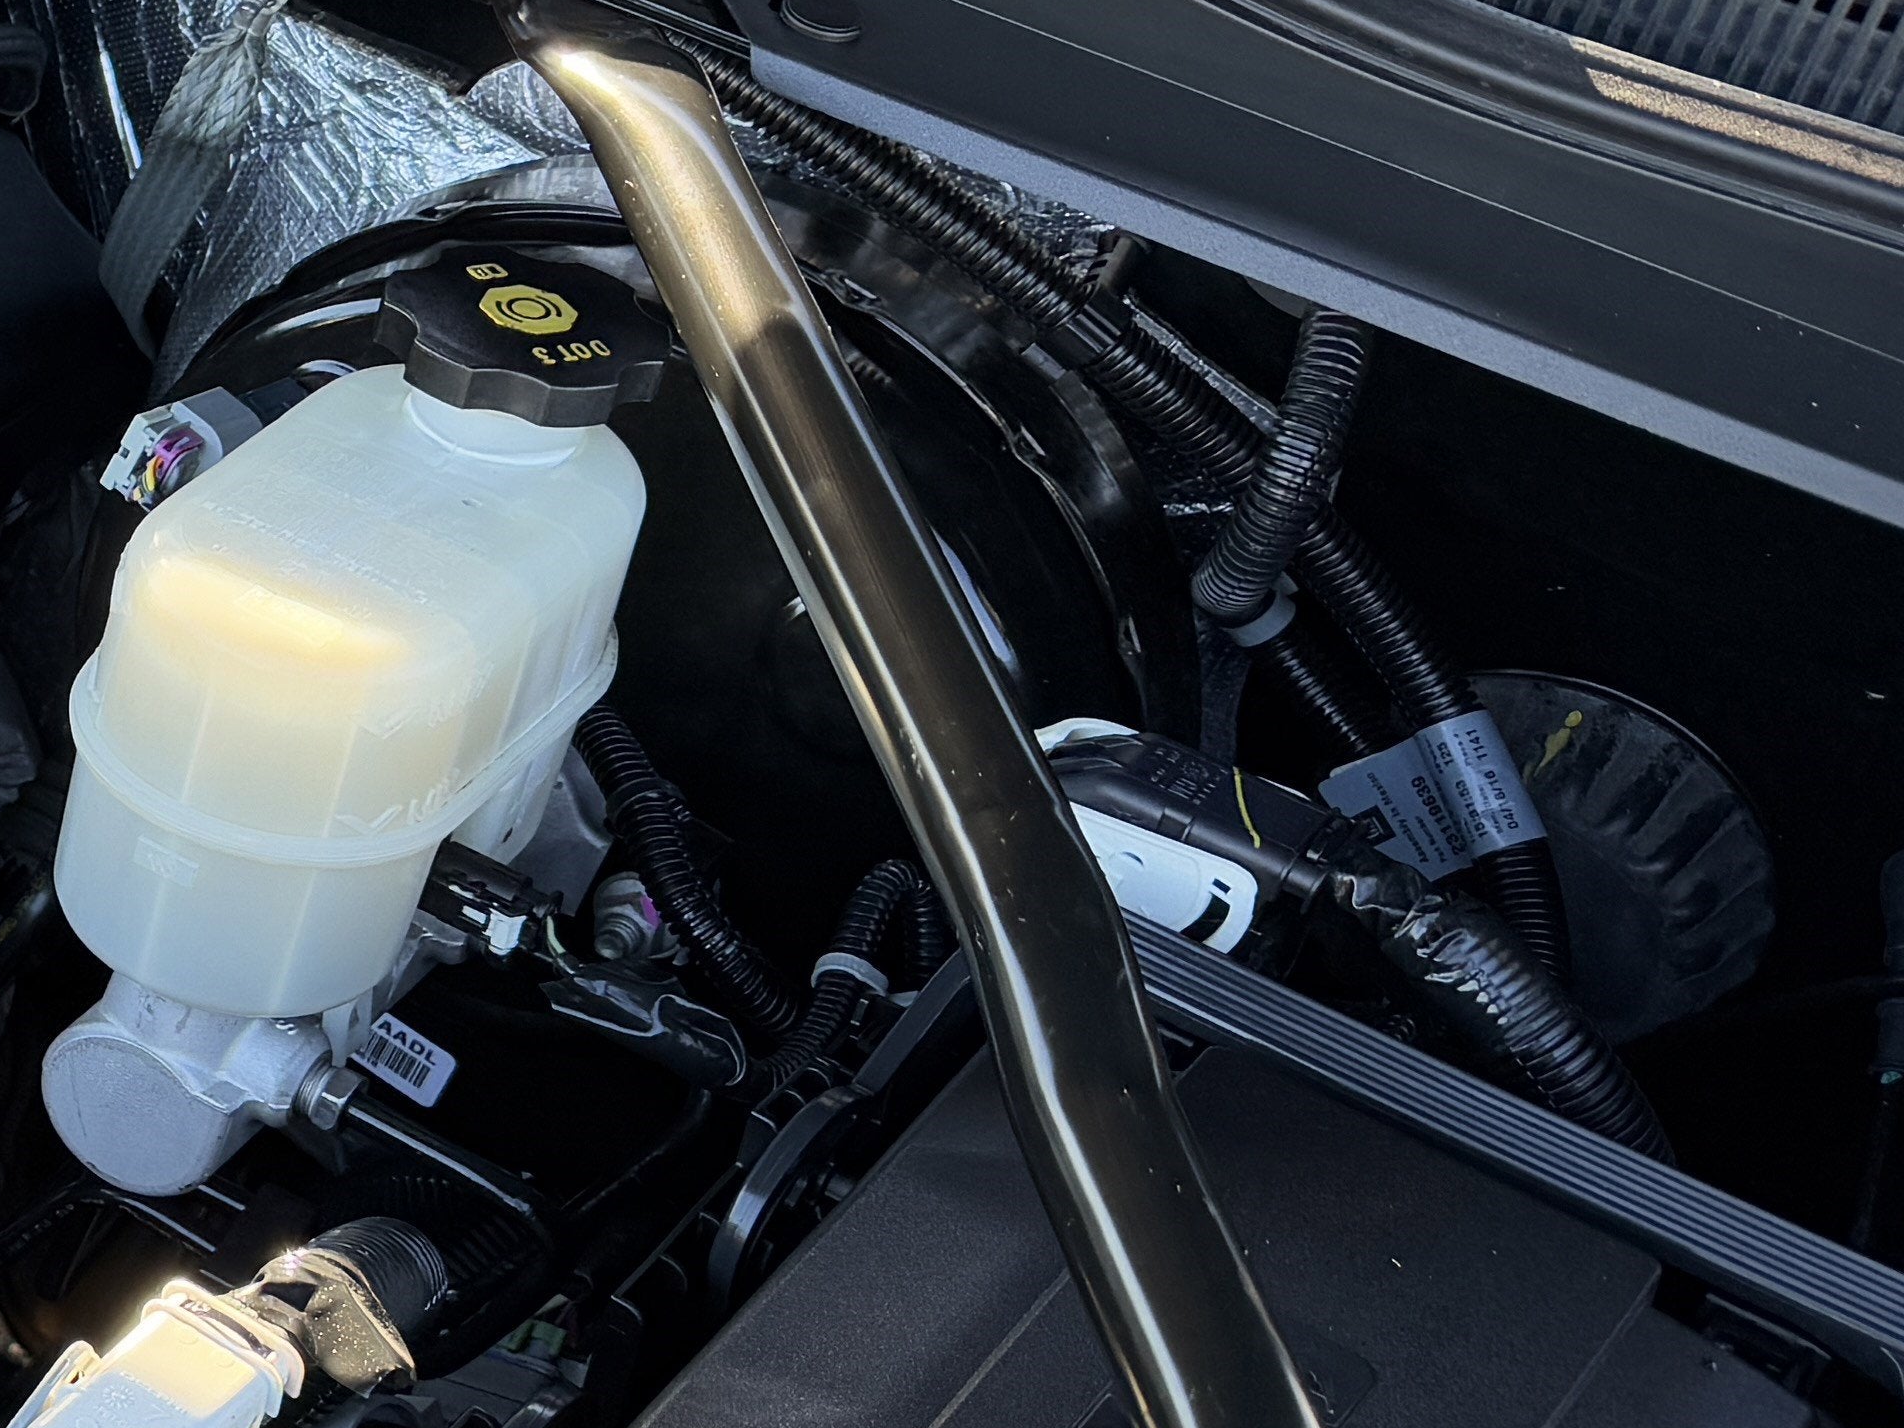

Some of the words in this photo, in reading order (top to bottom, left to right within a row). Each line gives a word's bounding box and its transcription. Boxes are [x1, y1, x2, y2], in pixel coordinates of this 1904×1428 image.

[557, 339, 611, 362] DOT
[1465, 729, 1488, 761] 1141
[377, 1020, 436, 1066] AADL
